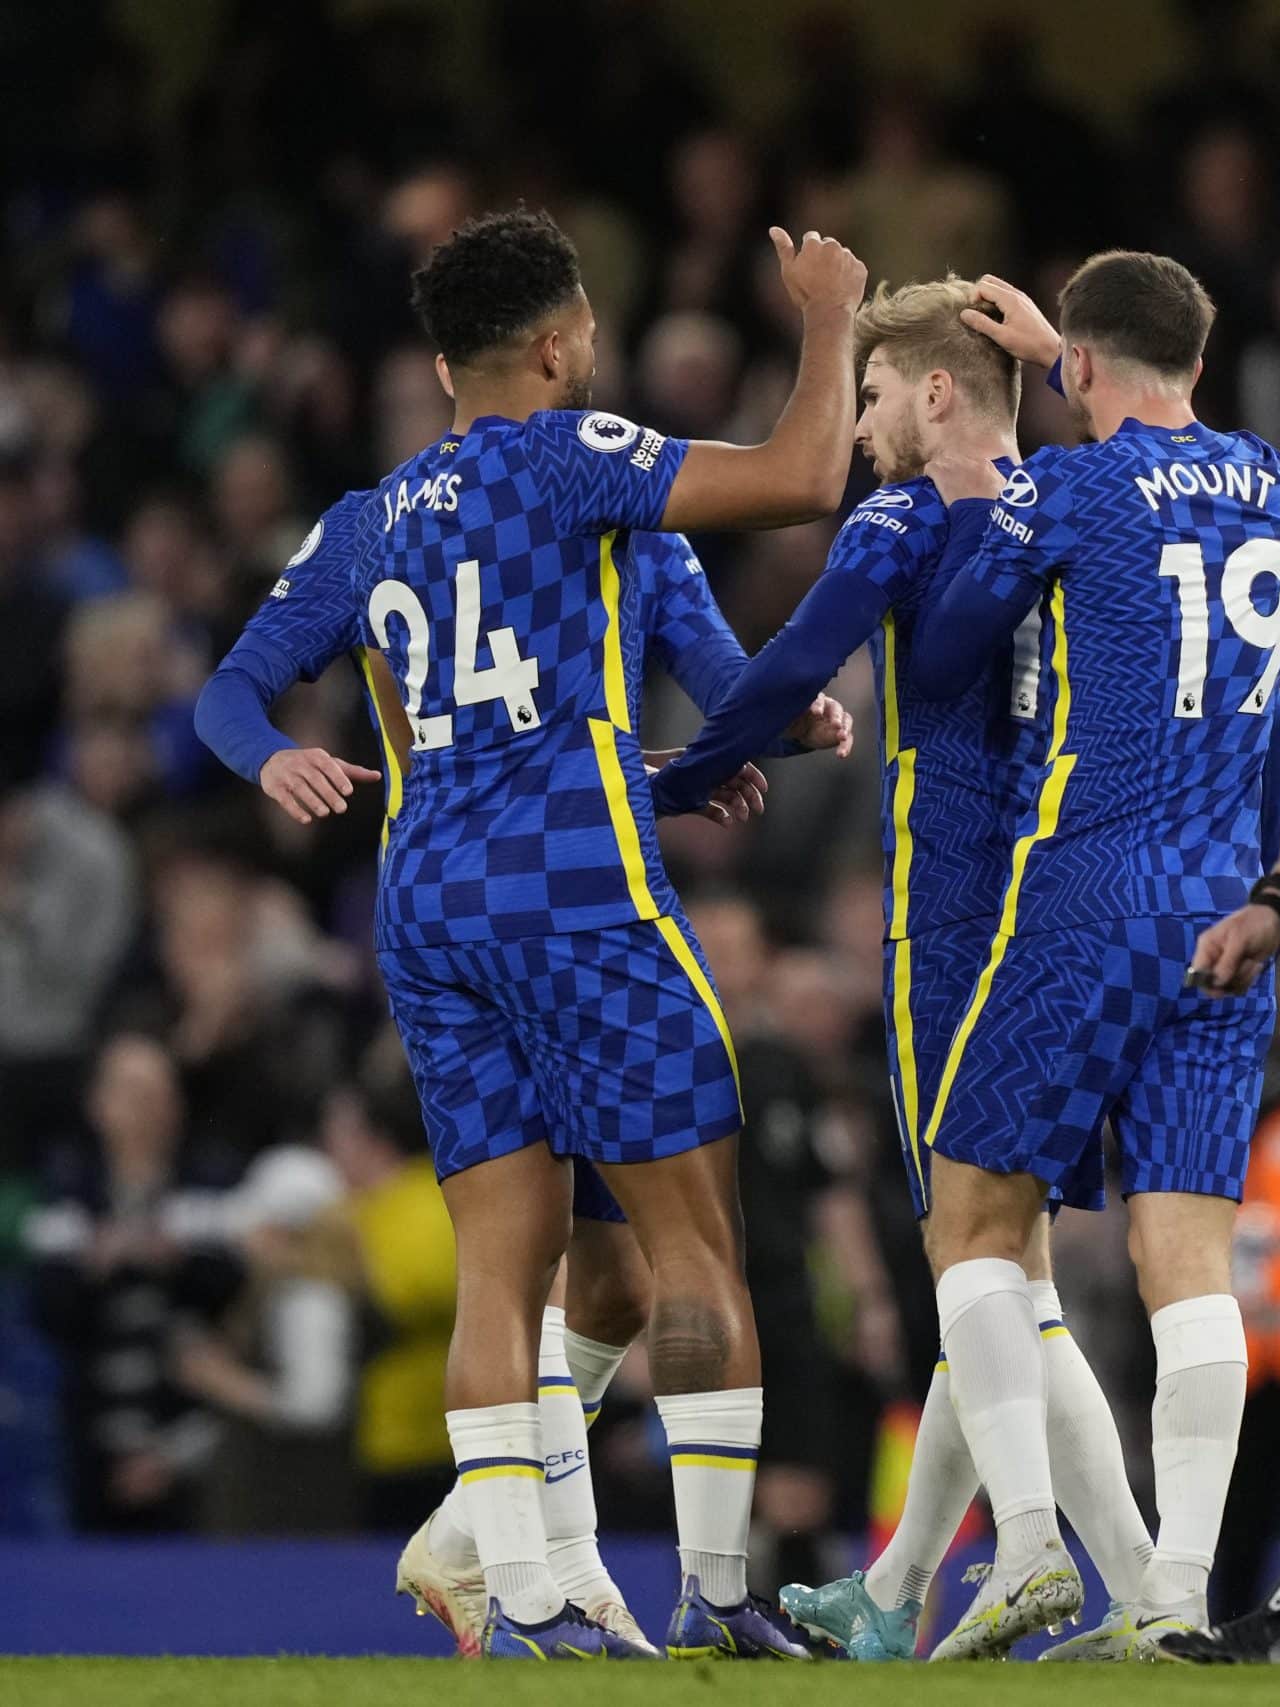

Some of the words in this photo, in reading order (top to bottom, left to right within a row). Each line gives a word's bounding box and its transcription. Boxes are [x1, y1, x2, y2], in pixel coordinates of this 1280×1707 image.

[629, 446, 647, 467] No
[384, 472, 462, 533] JAMES
[1135, 463, 1276, 511] MOUNT
[368, 559, 542, 752] 24
[545, 1449, 585, 1467] CFC
